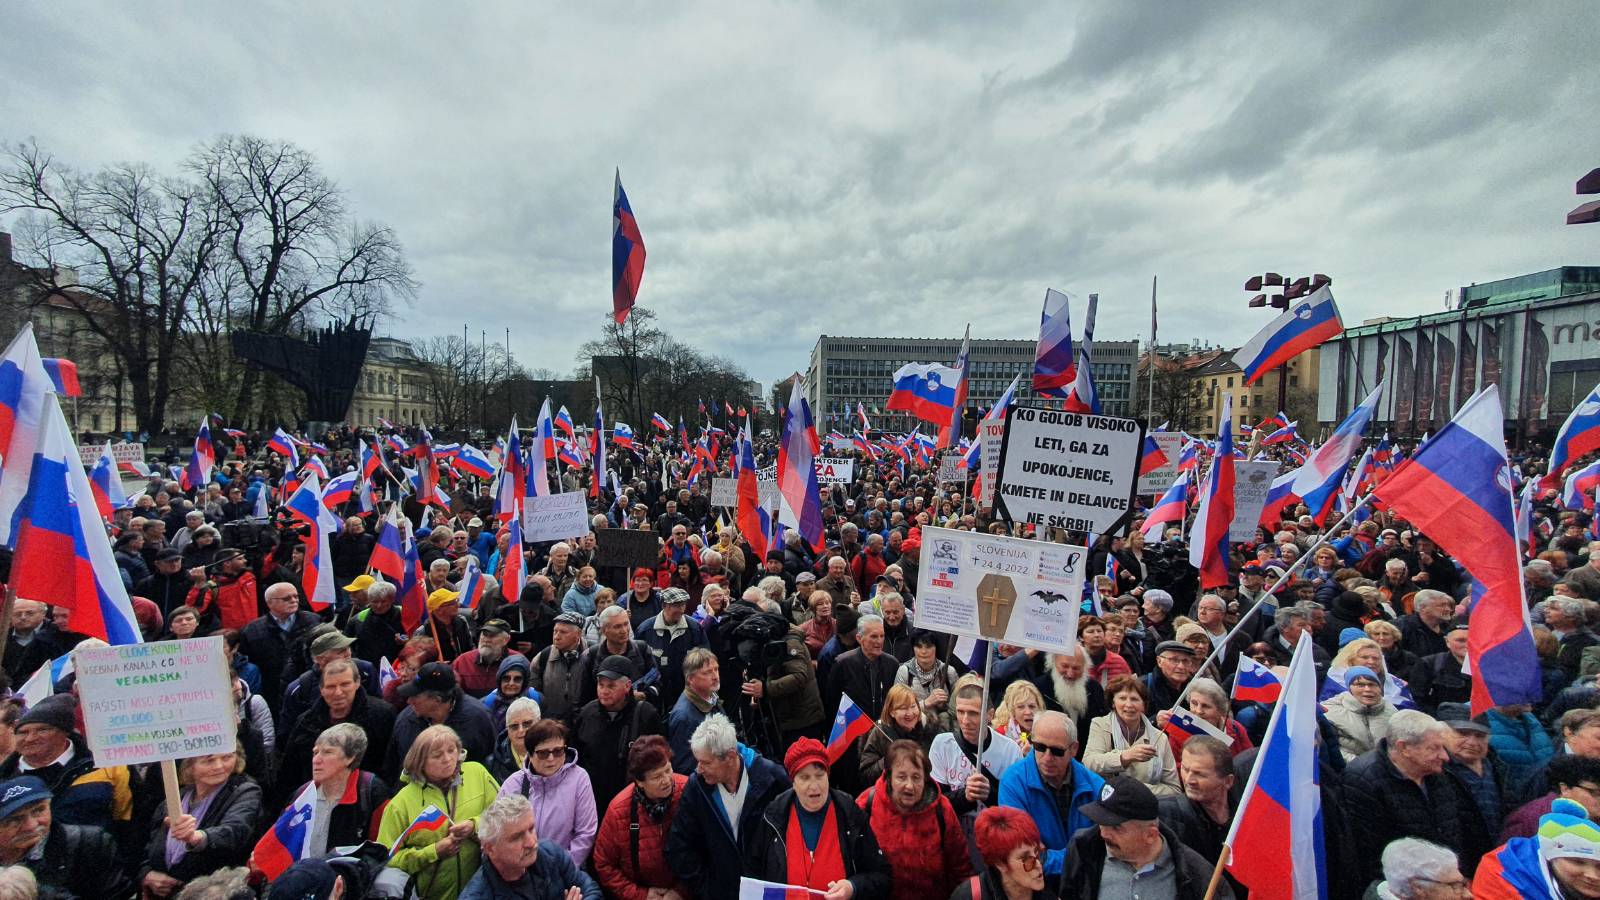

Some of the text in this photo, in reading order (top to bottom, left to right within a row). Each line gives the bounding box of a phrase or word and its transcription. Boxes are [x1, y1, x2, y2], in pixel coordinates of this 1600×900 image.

[1016, 408, 1136, 433] KO GOLOB VISOKO
[1034, 436, 1109, 456] LETI, GA ZA
[816, 464, 835, 476] ZA
[1022, 460, 1114, 485] UPOKOJENCE,
[1002, 483, 1047, 500] KMETE
[1050, 489, 1064, 502] IN
[1068, 491, 1128, 511] DELAVCE
[1026, 512, 1094, 532] NE SKRBI!
[976, 544, 1028, 560] SLOVENIJA
[981, 559, 1029, 575] 24.4.2022
[123, 660, 158, 672] KANALA
[150, 727, 185, 740] VOJSKA
